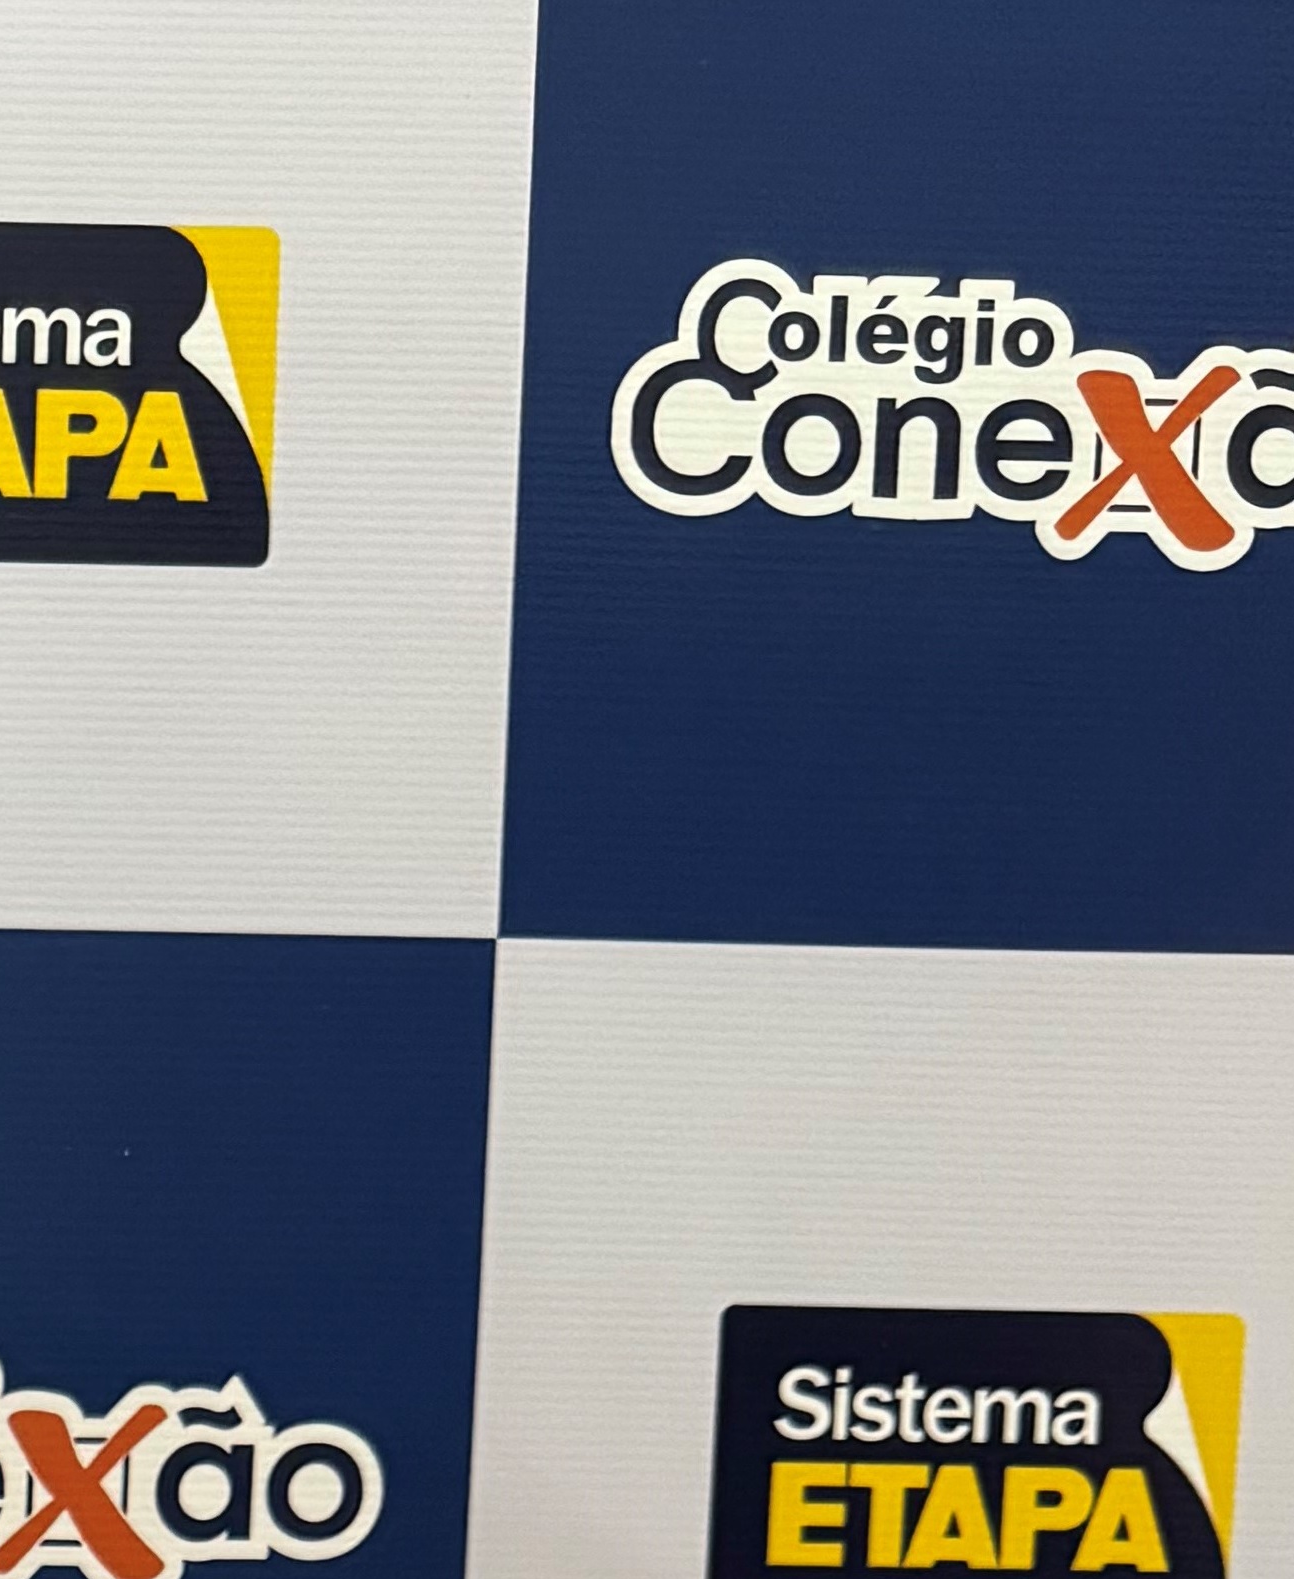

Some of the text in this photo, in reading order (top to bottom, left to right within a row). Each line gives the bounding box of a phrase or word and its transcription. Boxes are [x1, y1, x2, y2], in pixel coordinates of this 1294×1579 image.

[698, 278, 1055, 386] Colégio
[772, 1363, 1102, 1446] Sistema
[765, 1462, 1170, 1574] ETAPA
